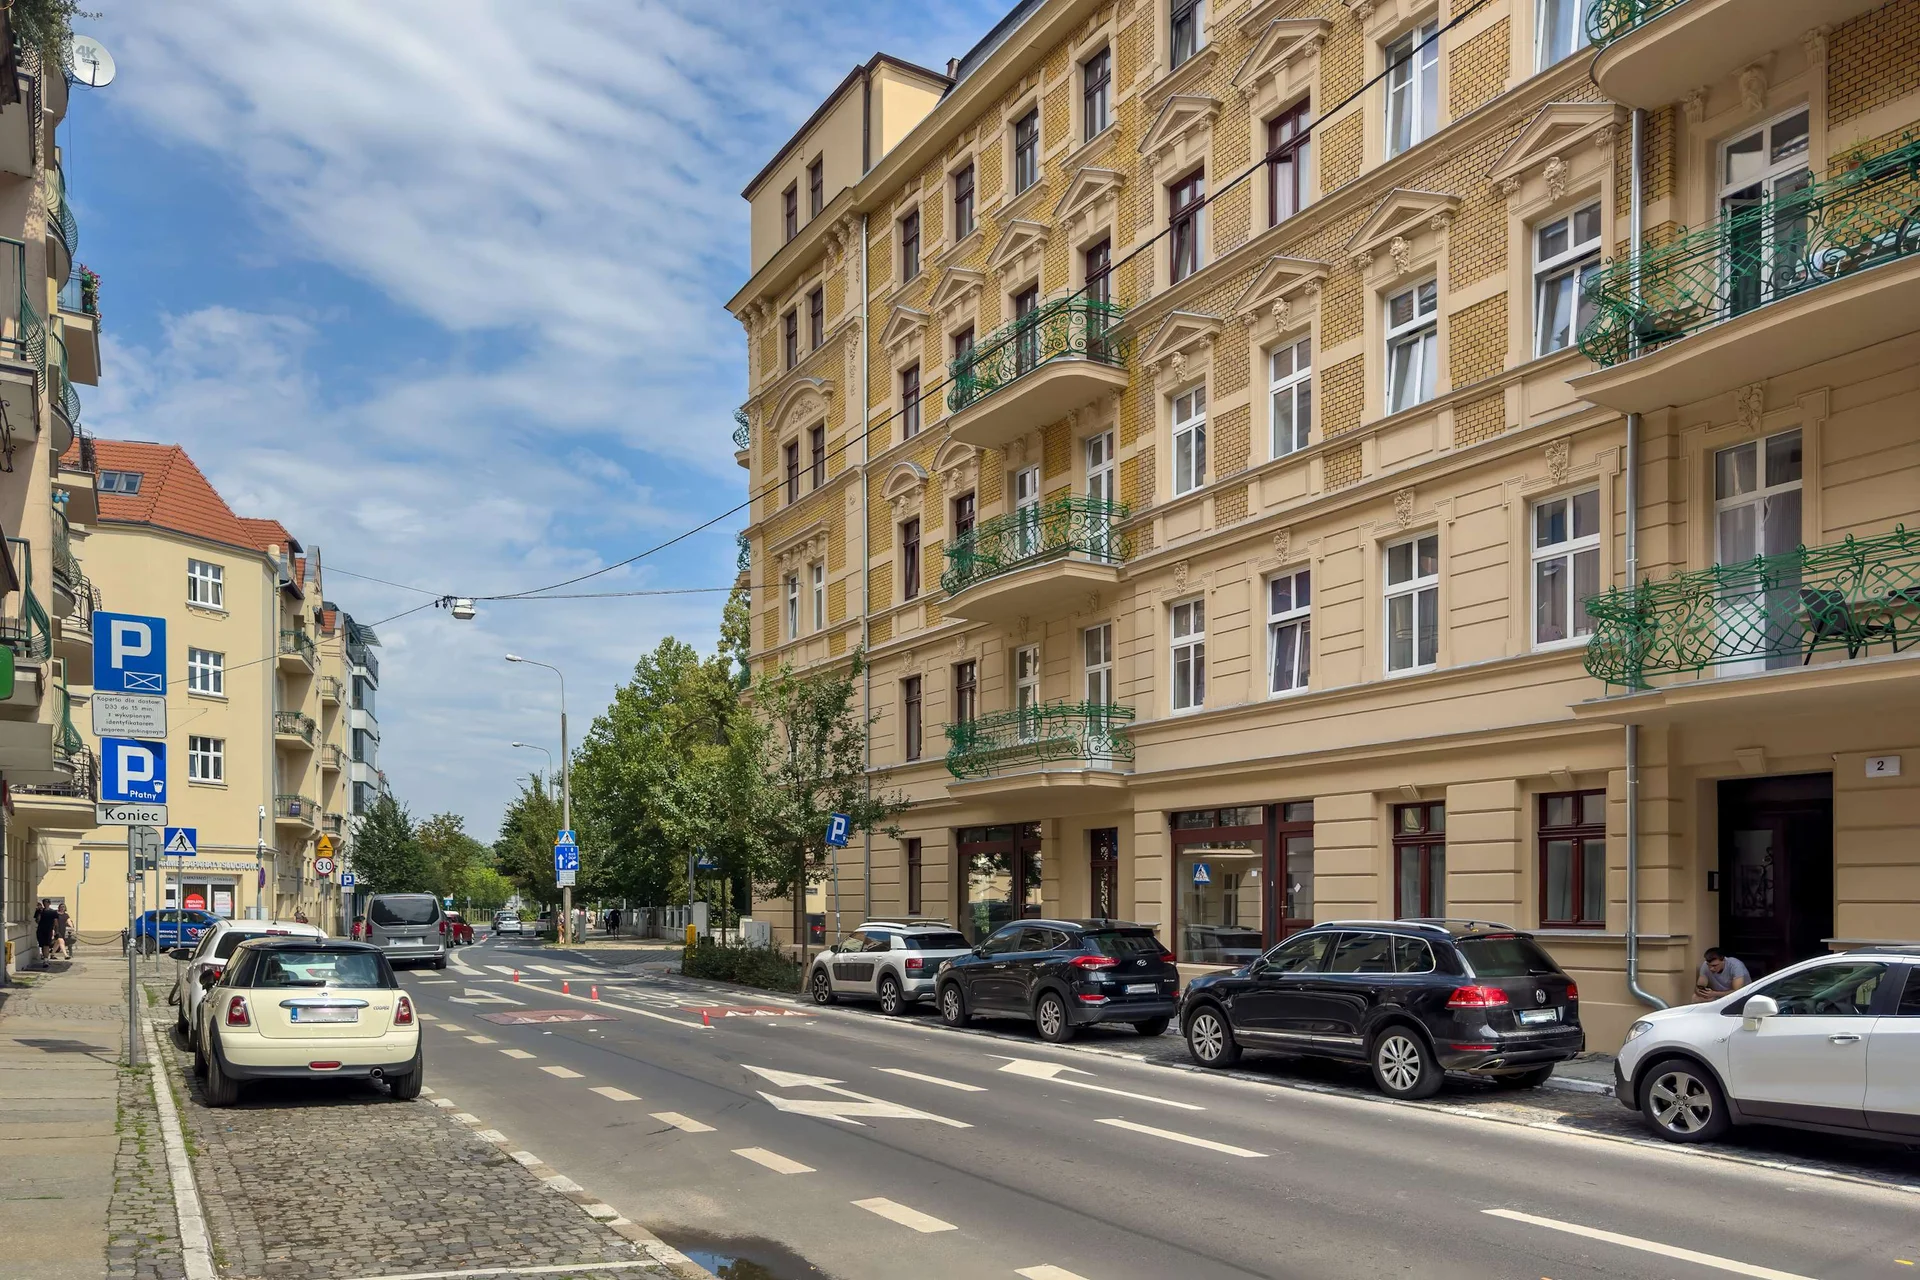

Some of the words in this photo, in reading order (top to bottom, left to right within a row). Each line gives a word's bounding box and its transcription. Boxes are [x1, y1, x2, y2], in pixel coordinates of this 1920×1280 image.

[75, 45, 98, 60] 4K
[110, 619, 152, 669] P
[117, 745, 154, 794] P
[1877, 760, 1884, 771] 2
[130, 790, 157, 801] Płatny
[105, 808, 158, 821] Koniec
[831, 816, 845, 840] P
[317, 861, 332, 871] 30
[343, 875, 352, 885] P
